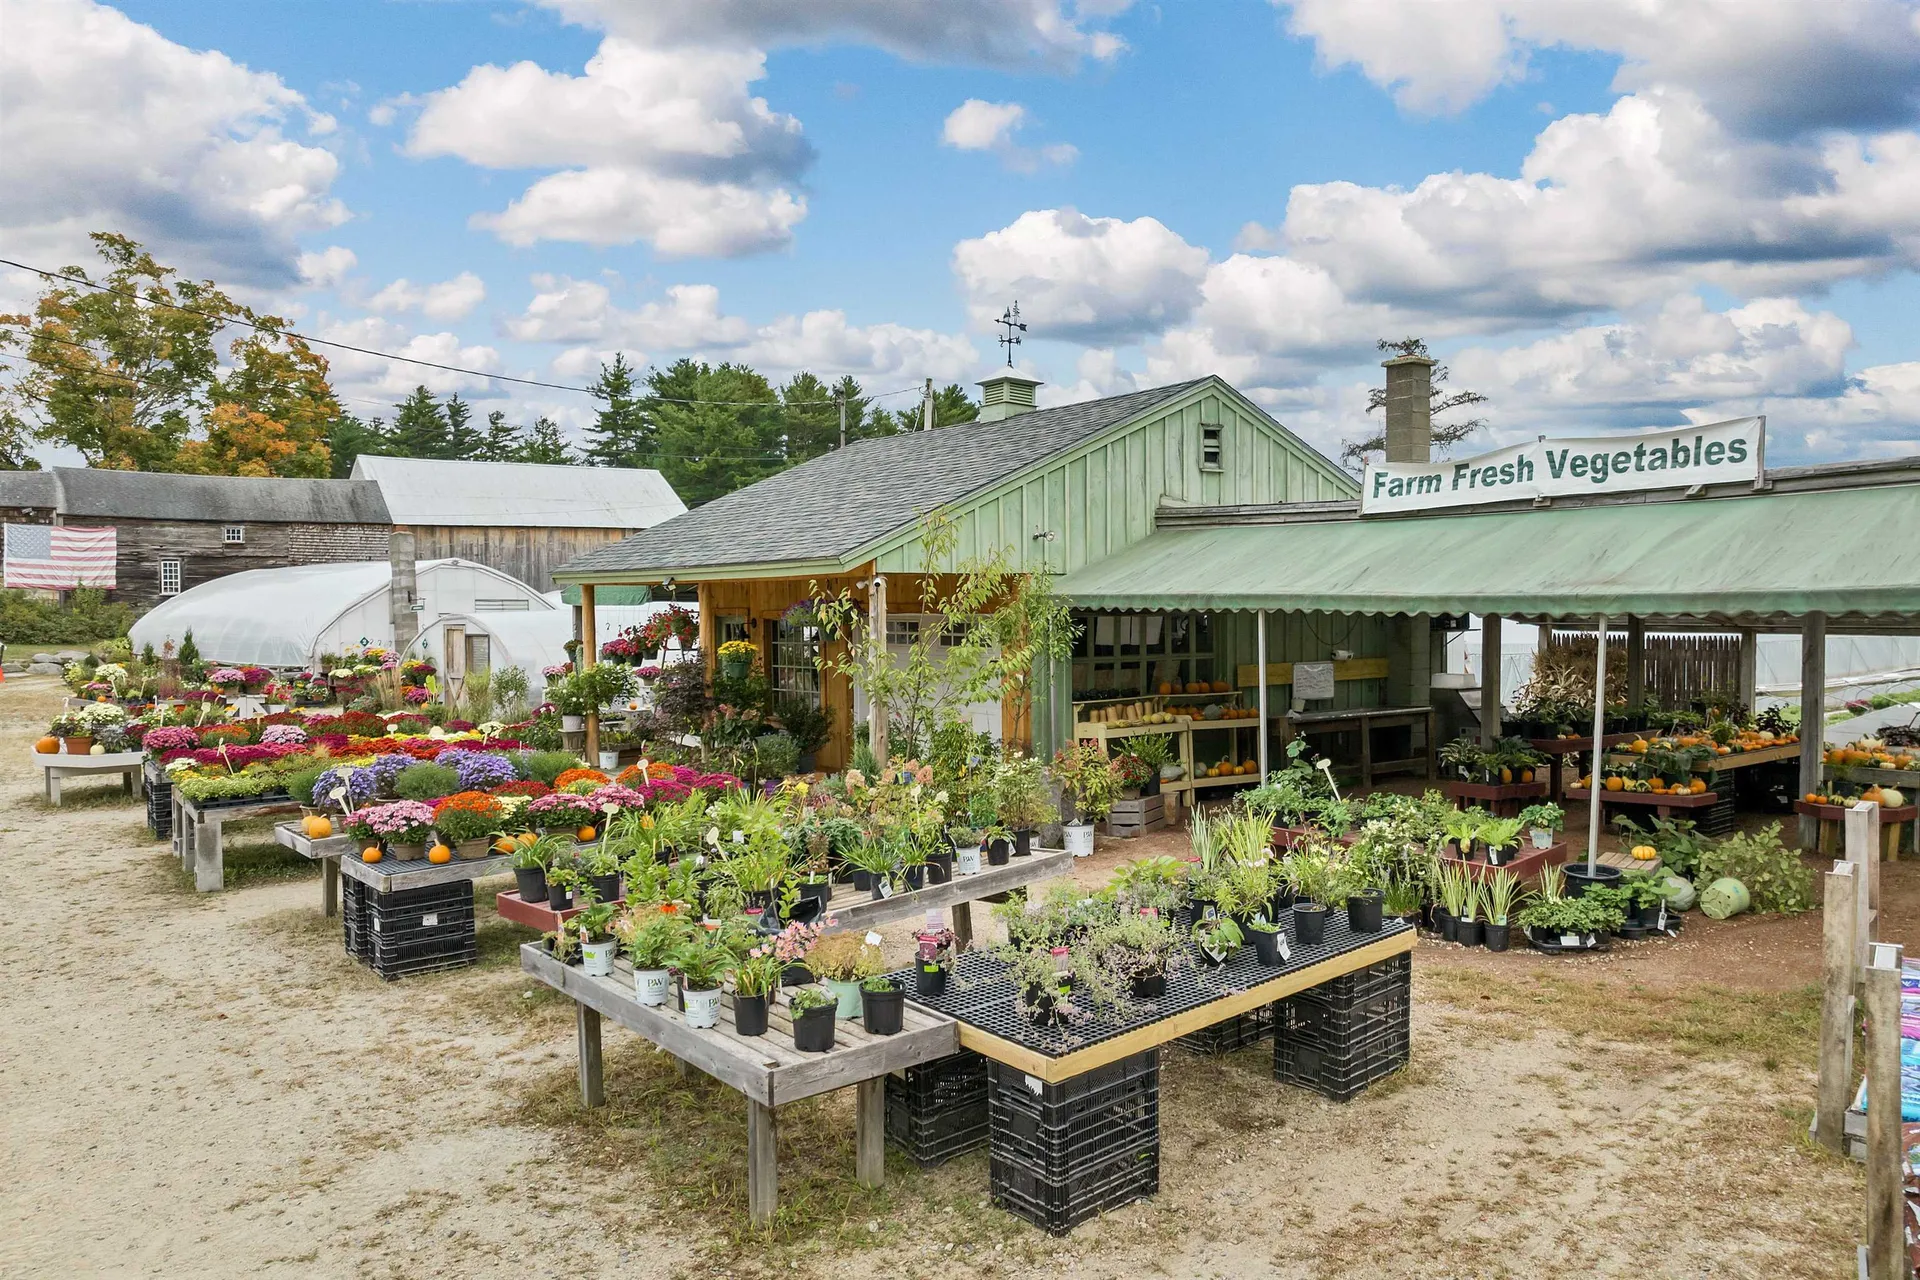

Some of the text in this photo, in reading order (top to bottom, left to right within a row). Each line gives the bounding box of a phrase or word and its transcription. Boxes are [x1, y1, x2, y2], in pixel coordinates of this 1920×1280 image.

[1372, 435, 1748, 499] Farm Fresh Vegetables
